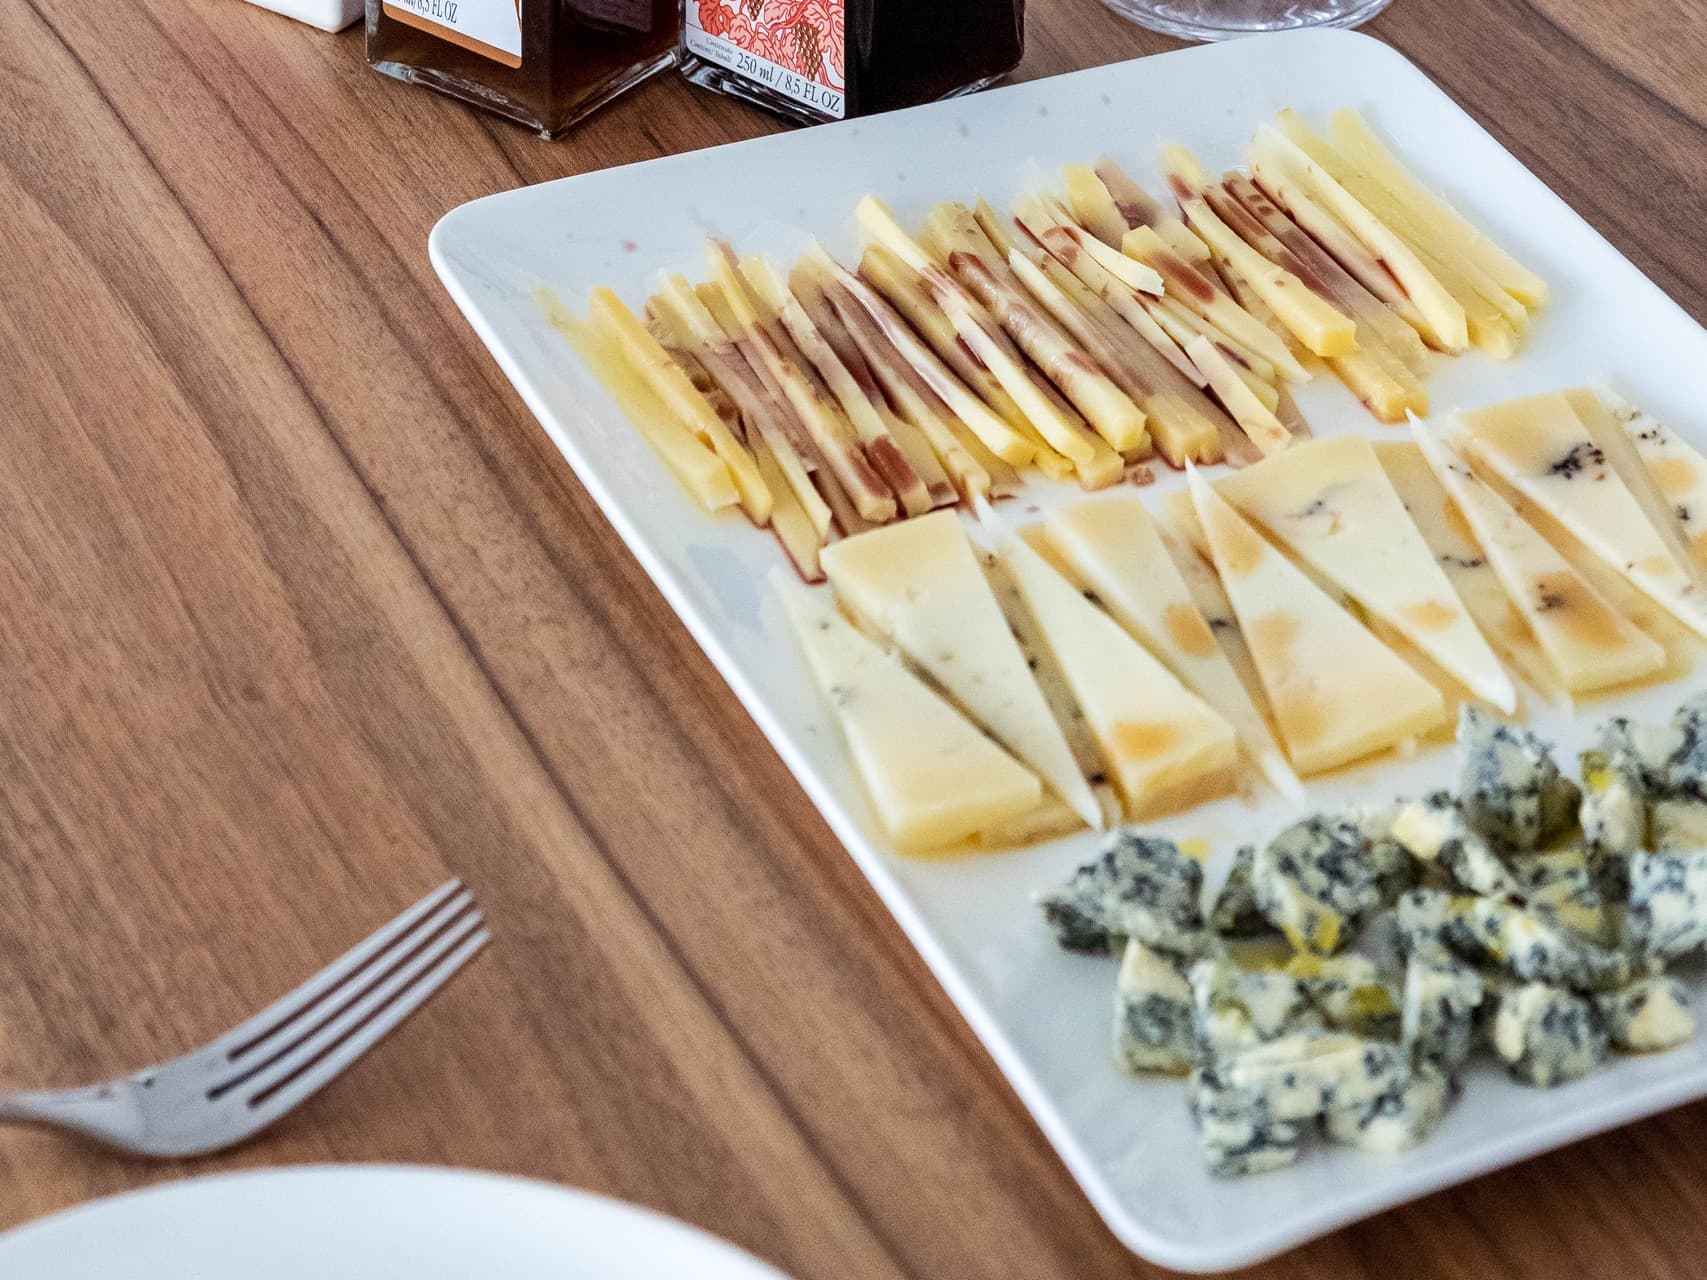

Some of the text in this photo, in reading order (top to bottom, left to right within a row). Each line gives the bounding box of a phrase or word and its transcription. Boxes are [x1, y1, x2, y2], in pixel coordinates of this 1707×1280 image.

[444, 1, 457, 24] OZ
[736, 52, 757, 74] 250
[759, 66, 774, 83] ml
[785, 74, 800, 96] 8,5
[803, 83, 819, 104] FL
[821, 91, 840, 112] OZ
